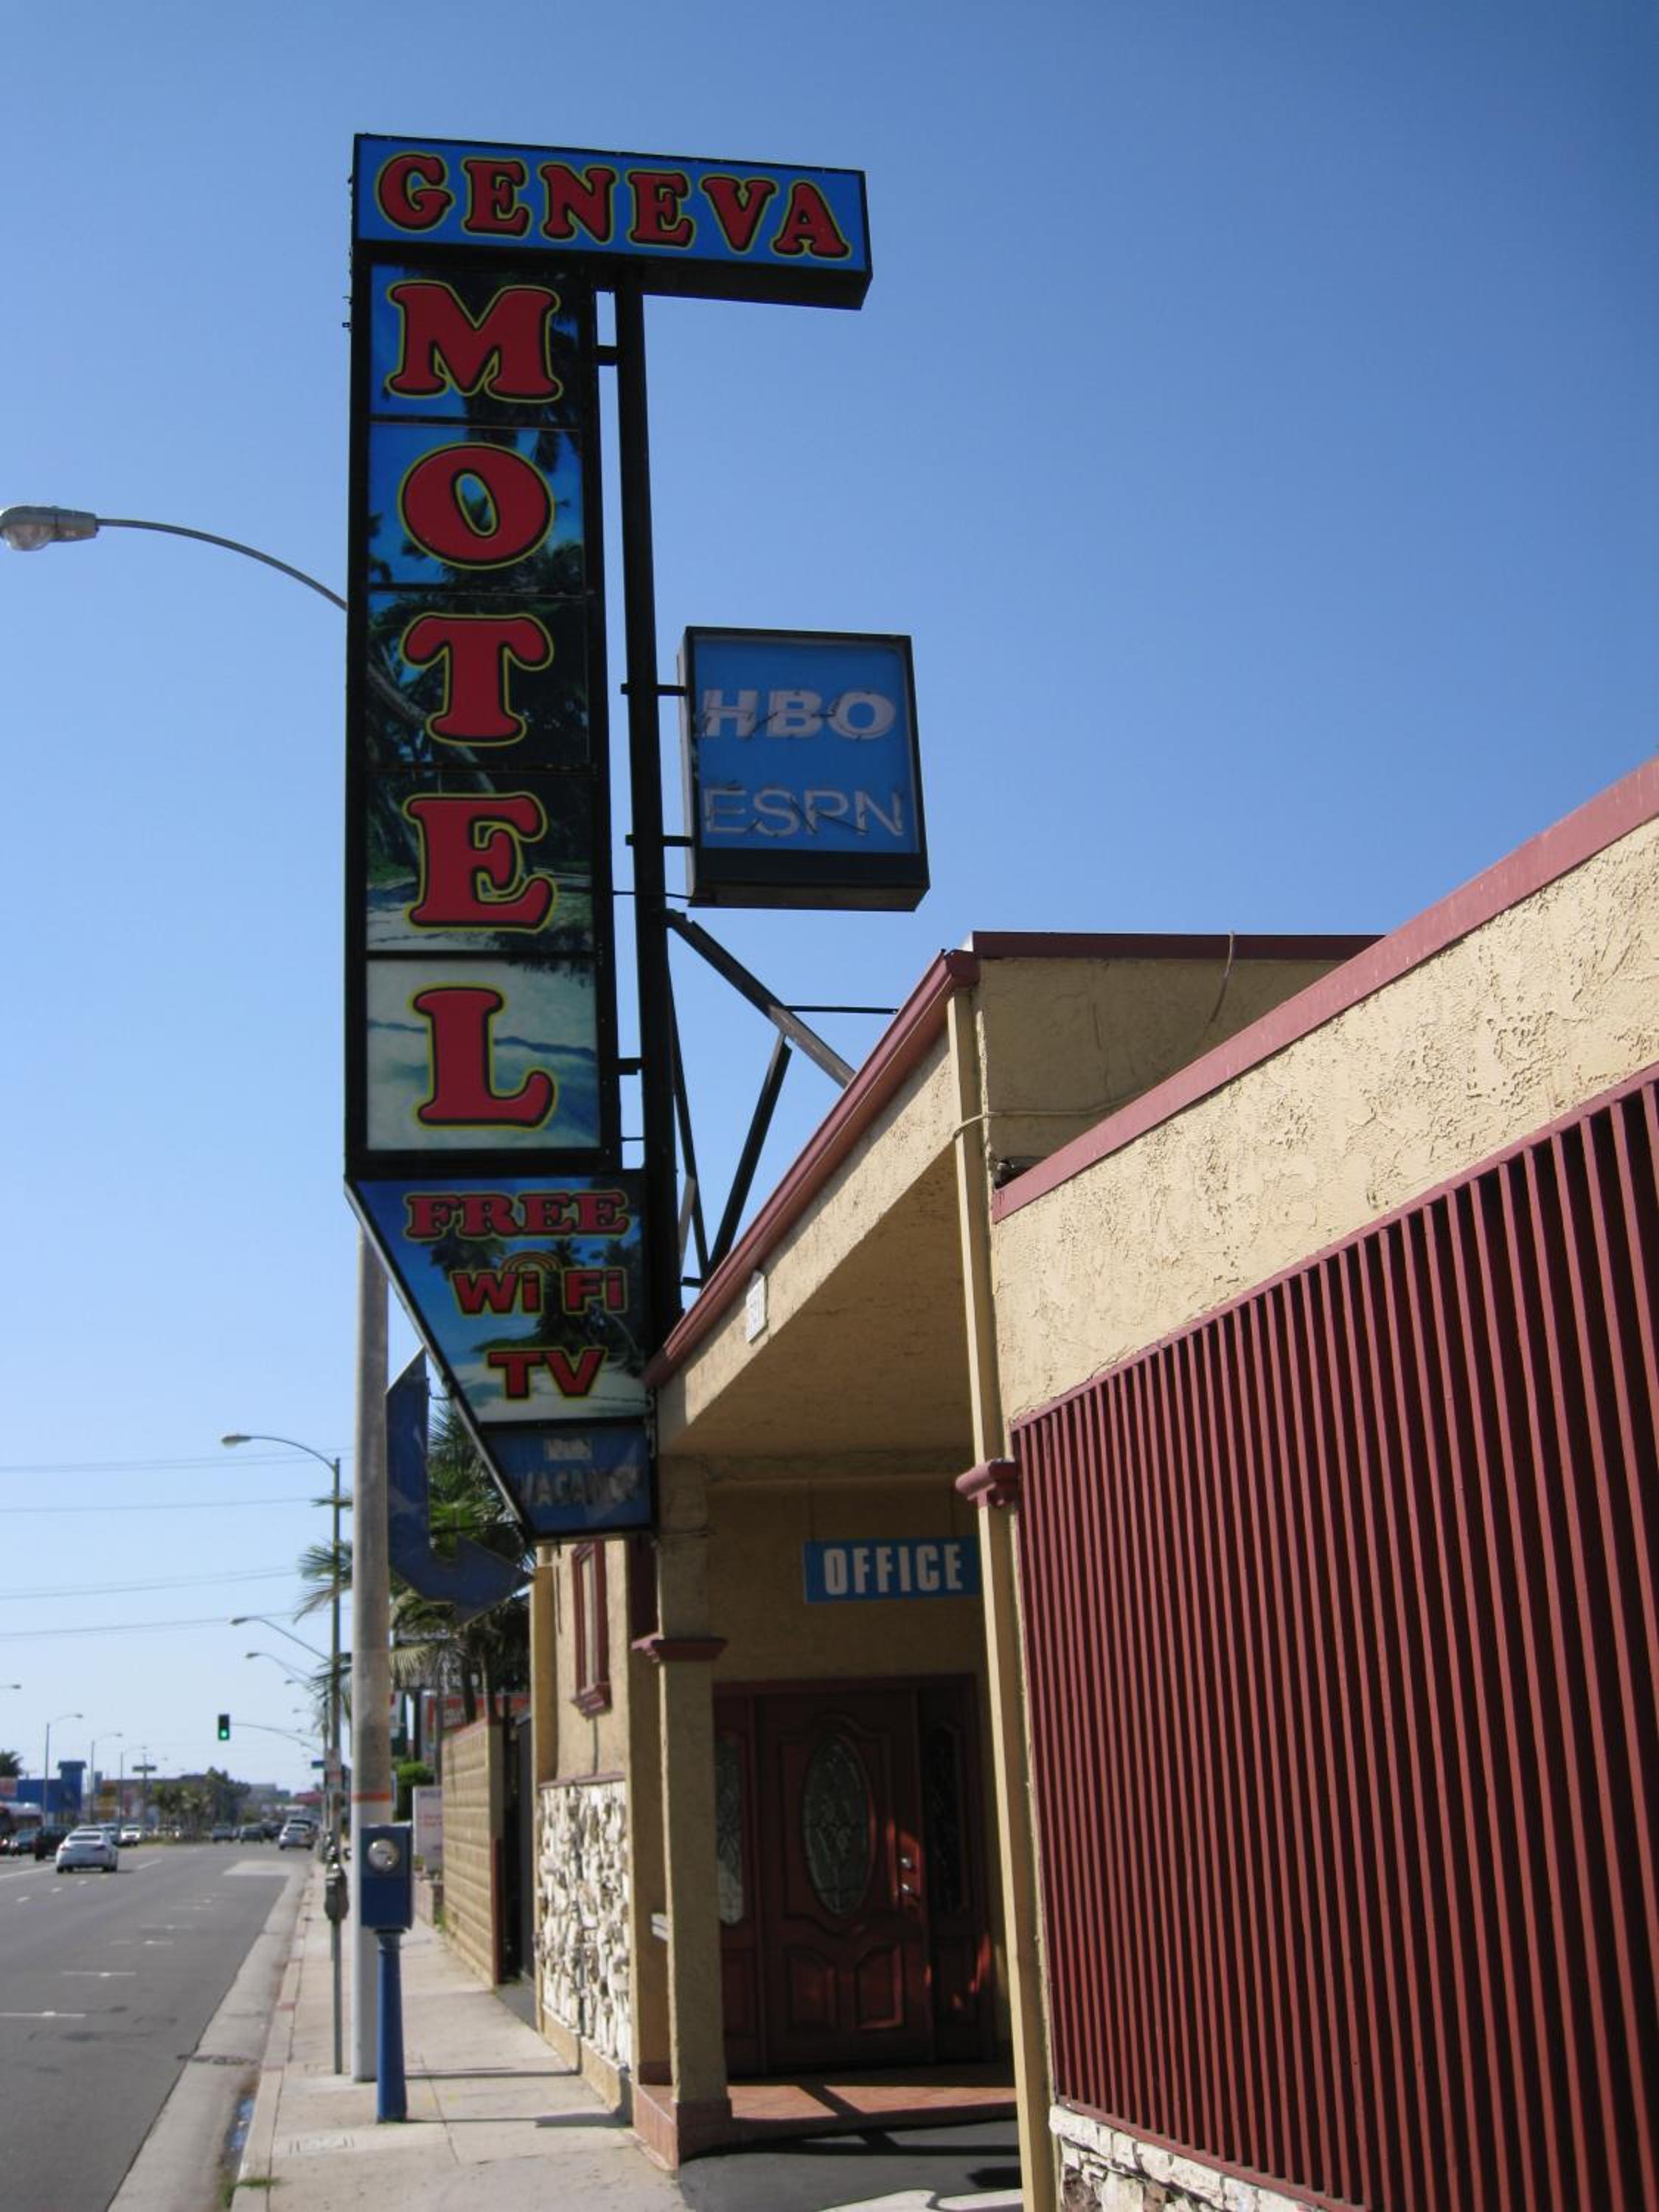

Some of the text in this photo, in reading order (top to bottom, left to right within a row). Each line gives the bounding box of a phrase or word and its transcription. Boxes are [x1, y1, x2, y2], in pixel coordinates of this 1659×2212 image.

[377, 153, 851, 260] GENEVA
[386, 281, 563, 1128] MOTEL
[703, 689, 897, 740] HBO
[703, 787, 904, 838] ESPN
[404, 1191, 630, 1240] FREE
[486, 1348, 606, 1400] TV
[823, 1545, 963, 1595] OFFICE
